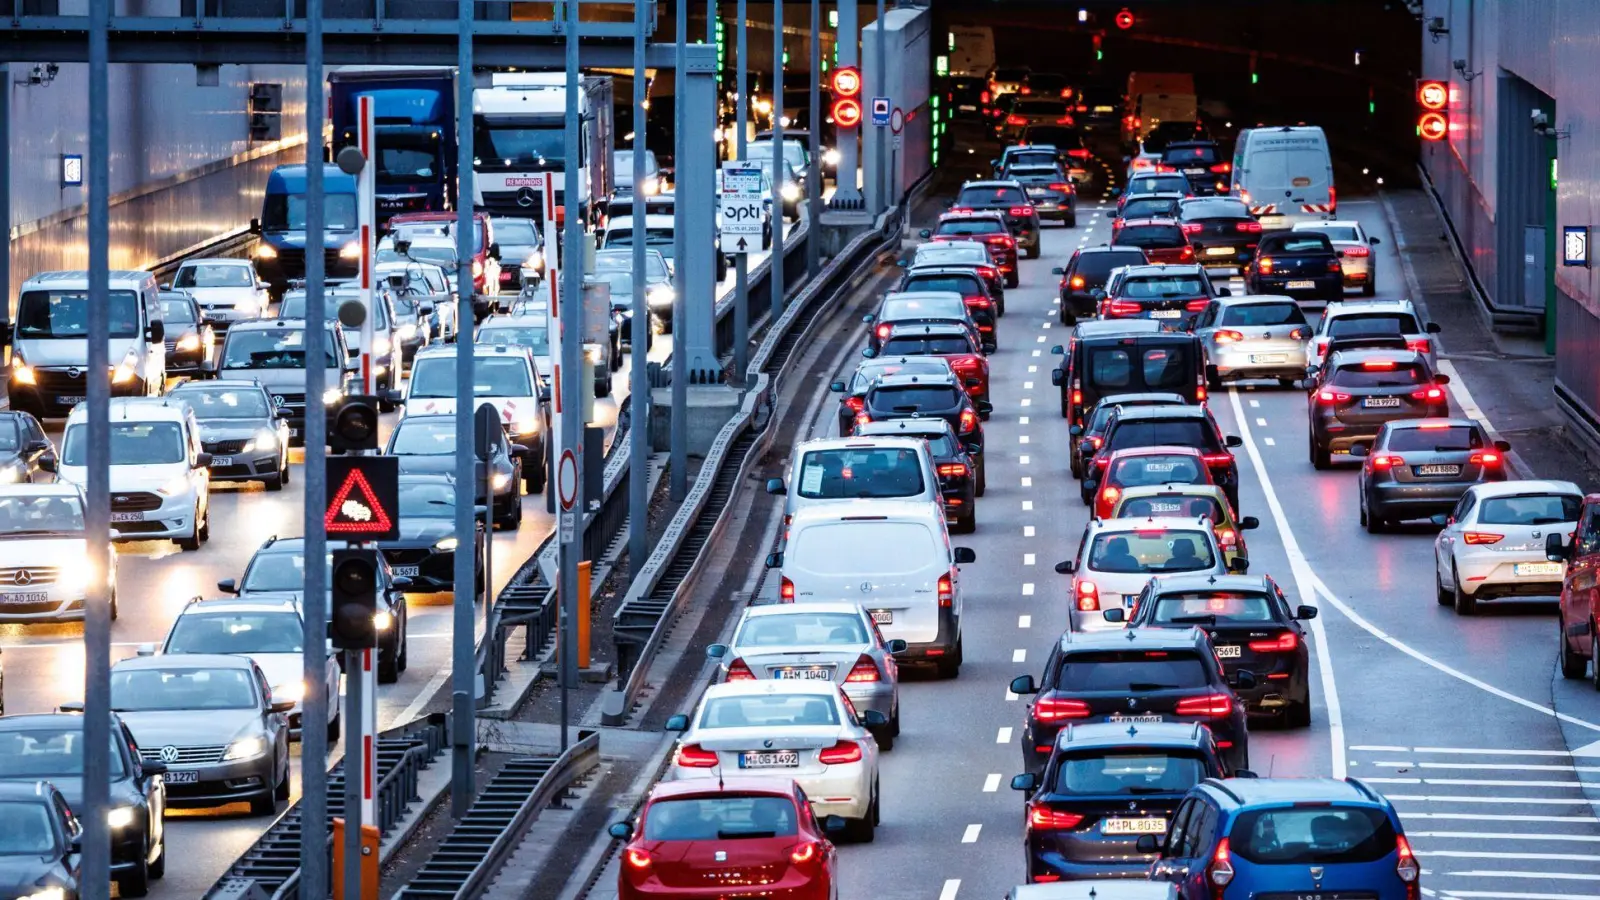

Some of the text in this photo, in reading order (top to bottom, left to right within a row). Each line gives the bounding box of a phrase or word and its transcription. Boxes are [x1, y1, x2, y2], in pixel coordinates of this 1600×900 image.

[507, 178, 542, 186] REMONDIS
[725, 204, 759, 221] opti
[26, 593, 46, 602] 1016
[805, 671, 827, 679] 1040
[773, 753, 797, 764] 1492
[173, 772, 197, 782] 1270
[1139, 819, 1164, 830] 8035
